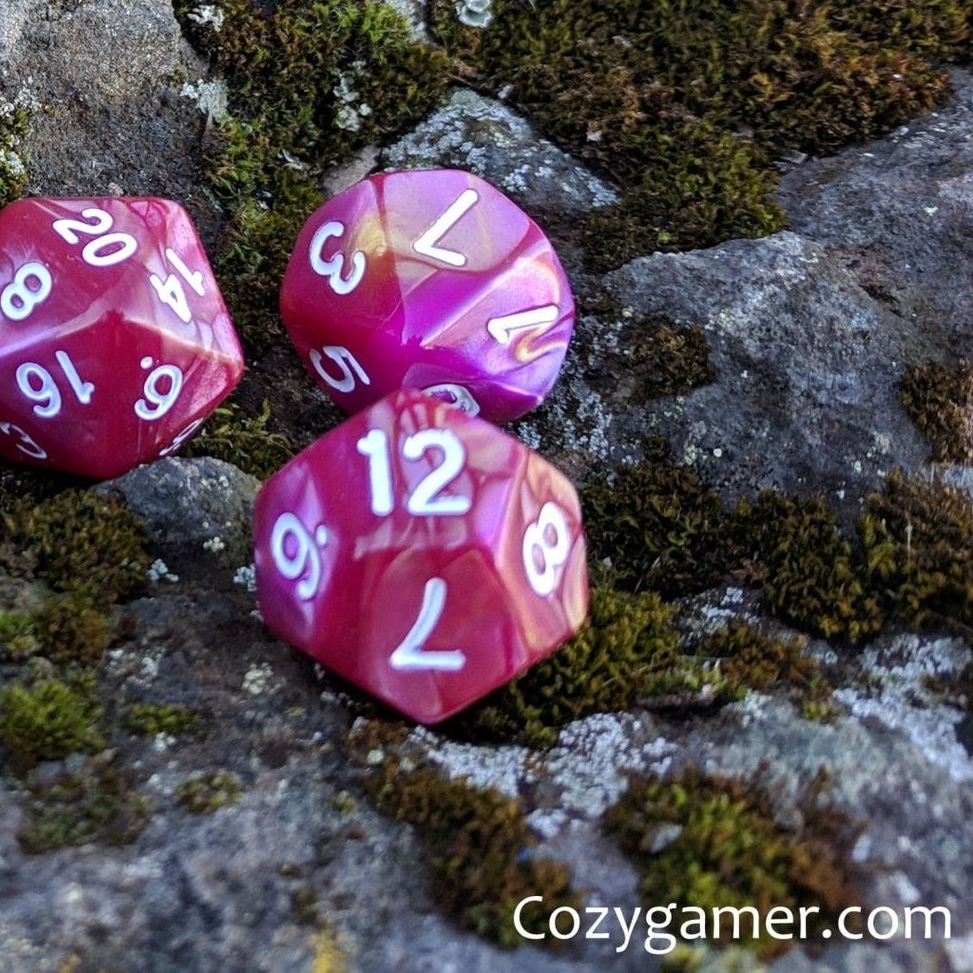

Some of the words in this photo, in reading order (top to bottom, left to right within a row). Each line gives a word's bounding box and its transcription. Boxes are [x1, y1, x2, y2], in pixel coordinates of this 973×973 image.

[53, 208, 137, 266] 20
[309, 221, 366, 295] 3
[413, 188, 478, 266] 7
[0, 261, 52, 320] 8
[150, 248, 205, 322] 14
[487, 304, 559, 344] 1
[16, 350, 95, 418] 16
[309, 346, 370, 393] 5
[0, 421, 47, 459] 3
[357, 429, 471, 516] 12
[523, 501, 570, 596] 8
[389, 577, 467, 671] 7
